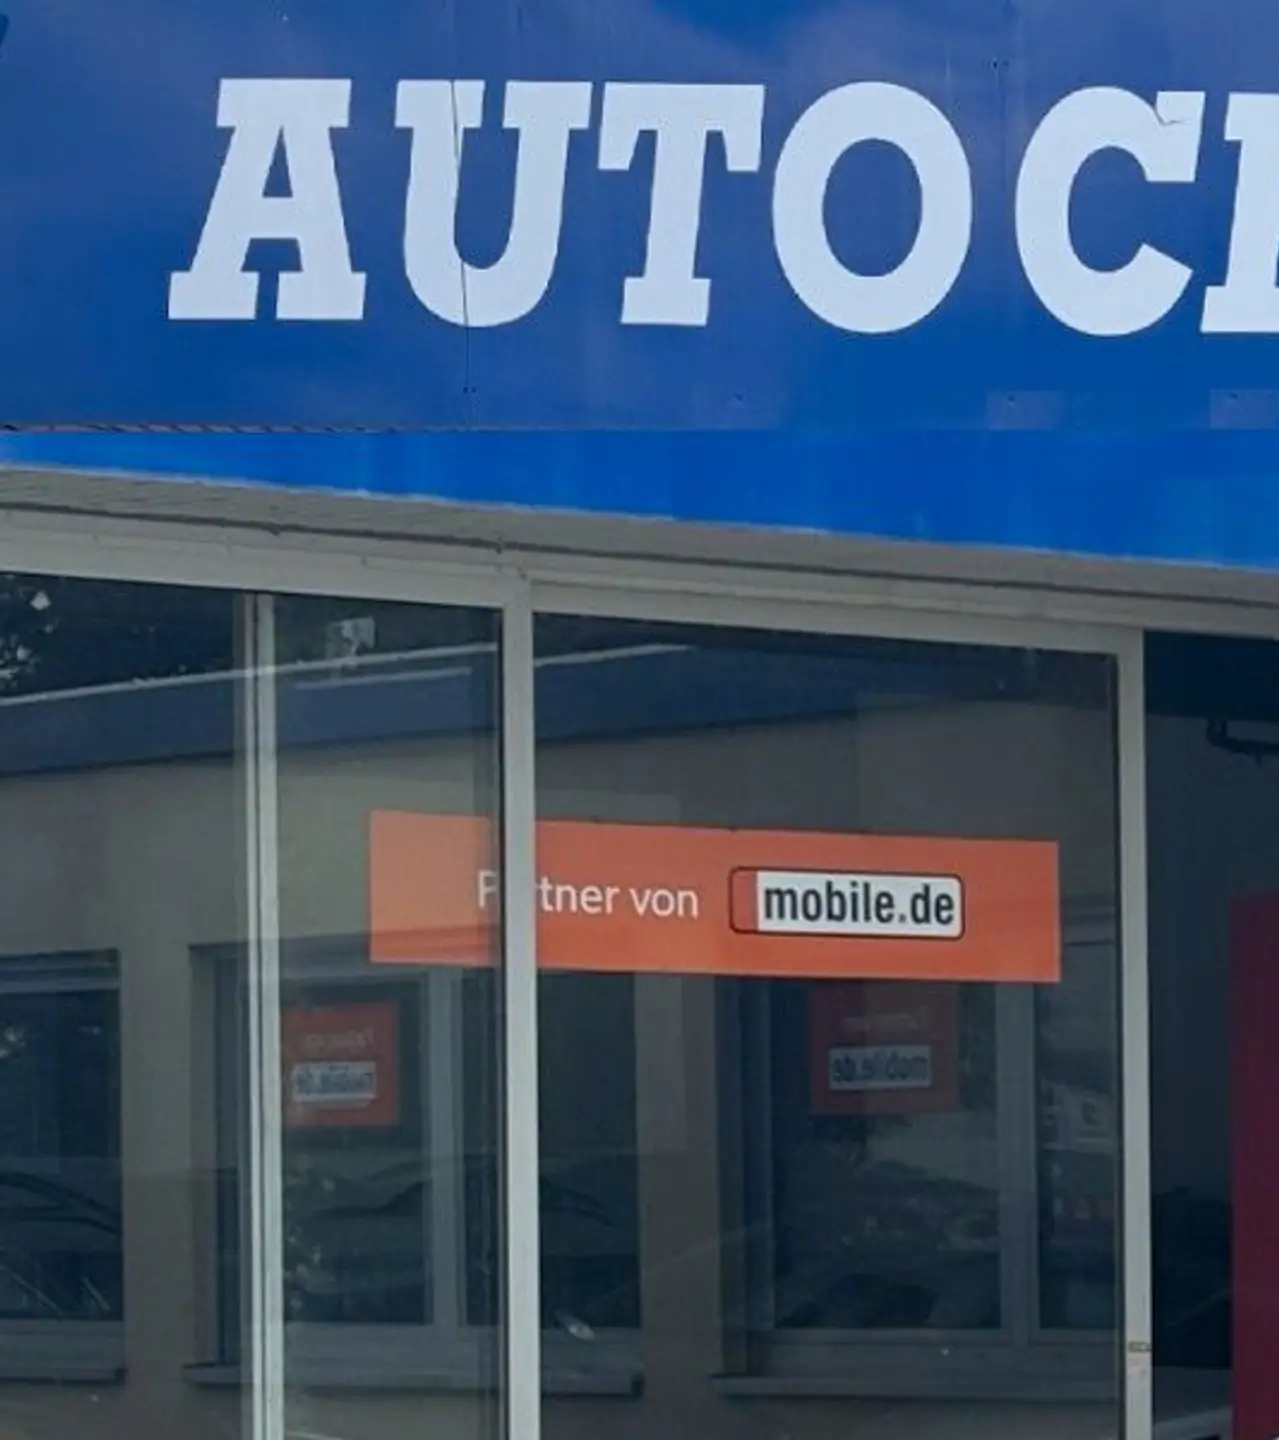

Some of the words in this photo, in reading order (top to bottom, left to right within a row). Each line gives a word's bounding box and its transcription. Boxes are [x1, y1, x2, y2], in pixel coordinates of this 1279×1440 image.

[478, 870, 620, 914] Ptner
[629, 888, 699, 917] von
[763, 880, 955, 925] mobile.de
